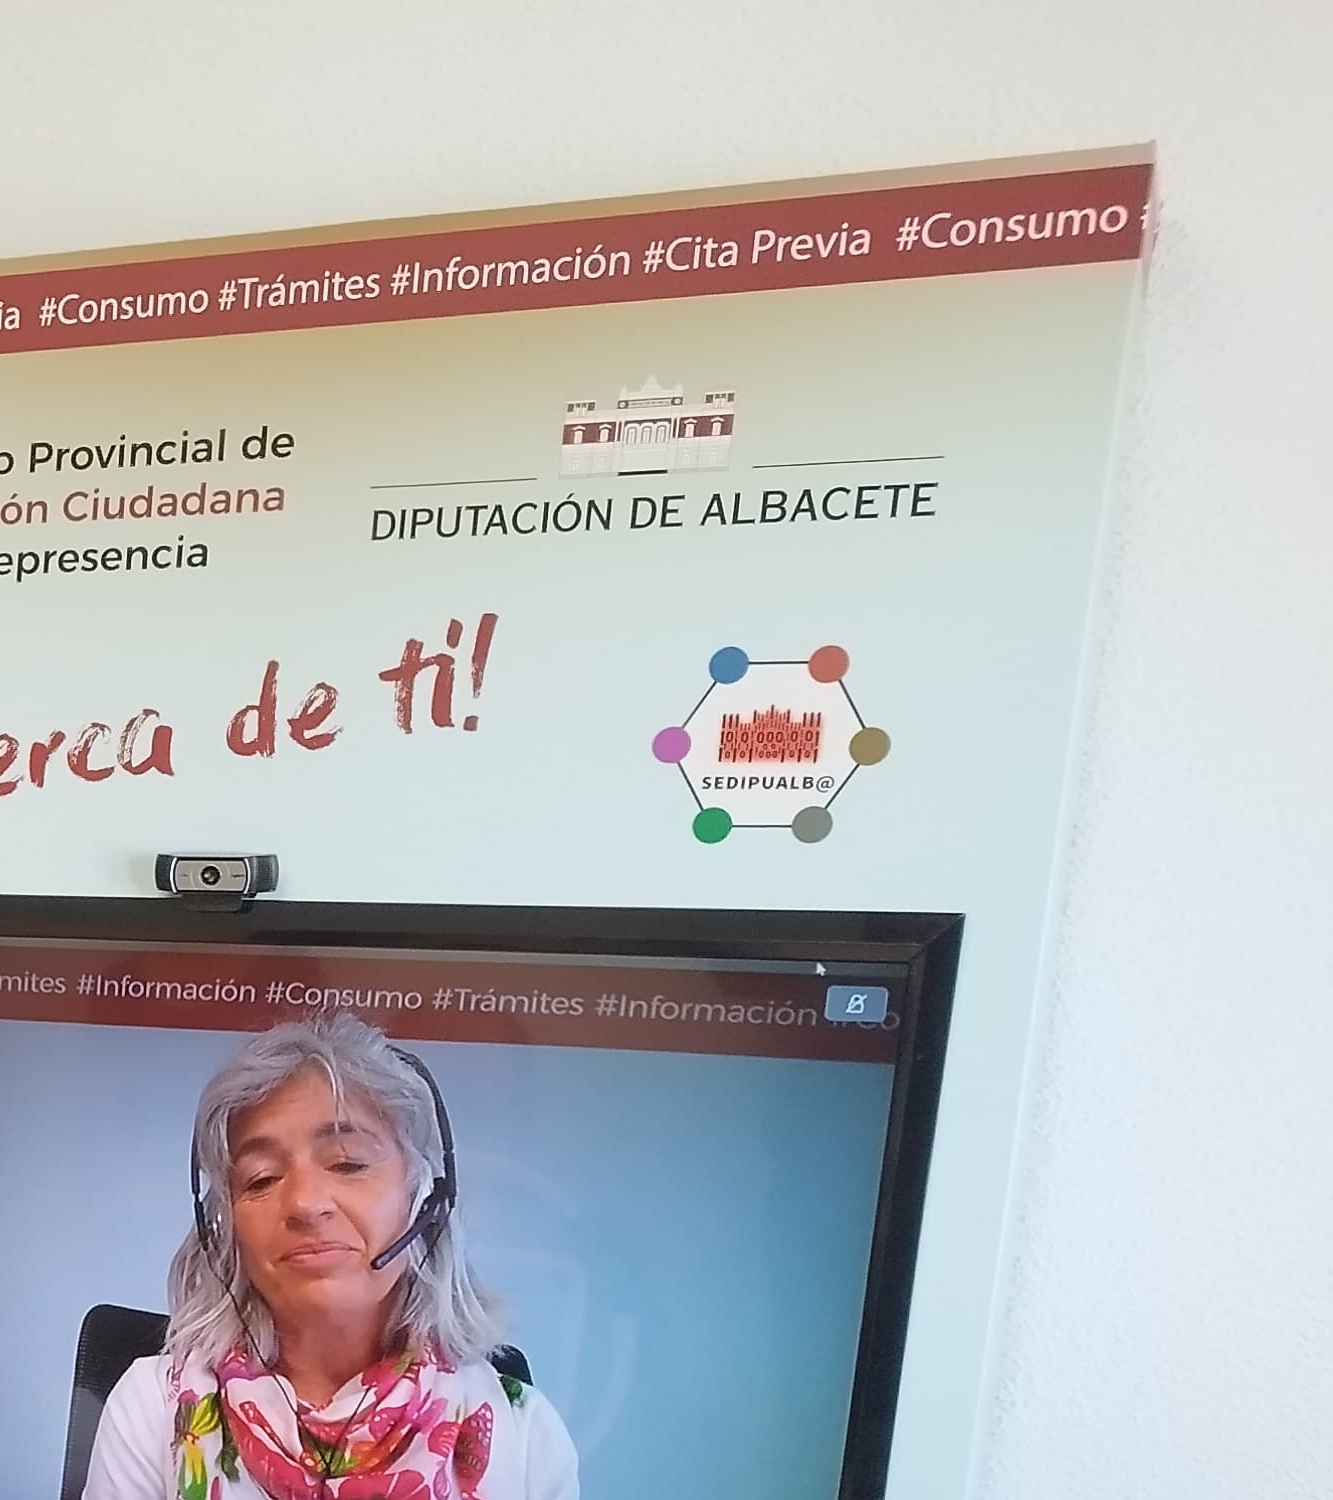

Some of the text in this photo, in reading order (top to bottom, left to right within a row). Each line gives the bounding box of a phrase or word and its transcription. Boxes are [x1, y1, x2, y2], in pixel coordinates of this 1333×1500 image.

[39, 285, 209, 329] #Consumo
[217, 270, 381, 311] #Trámites
[389, 245, 632, 297] #Información
[642, 235, 740, 275] #Cita
[751, 222, 872, 265] Previa
[895, 204, 1129, 254] #Consumo
[29, 427, 227, 474] Provincial
[241, 425, 295, 459] de
[62, 482, 287, 524] Ciudadana
[370, 482, 940, 541] DIPUTACIÓN DE ALBACETE
[226, 660, 345, 758] de
[378, 612, 500, 735] ti!
[701, 775, 835, 793] SEDIPUALB@
[77, 972, 256, 1004] #Información
[265, 982, 423, 1013] #Consumo
[432, 987, 585, 1017] #Trámites
[595, 992, 818, 1027] #Información
